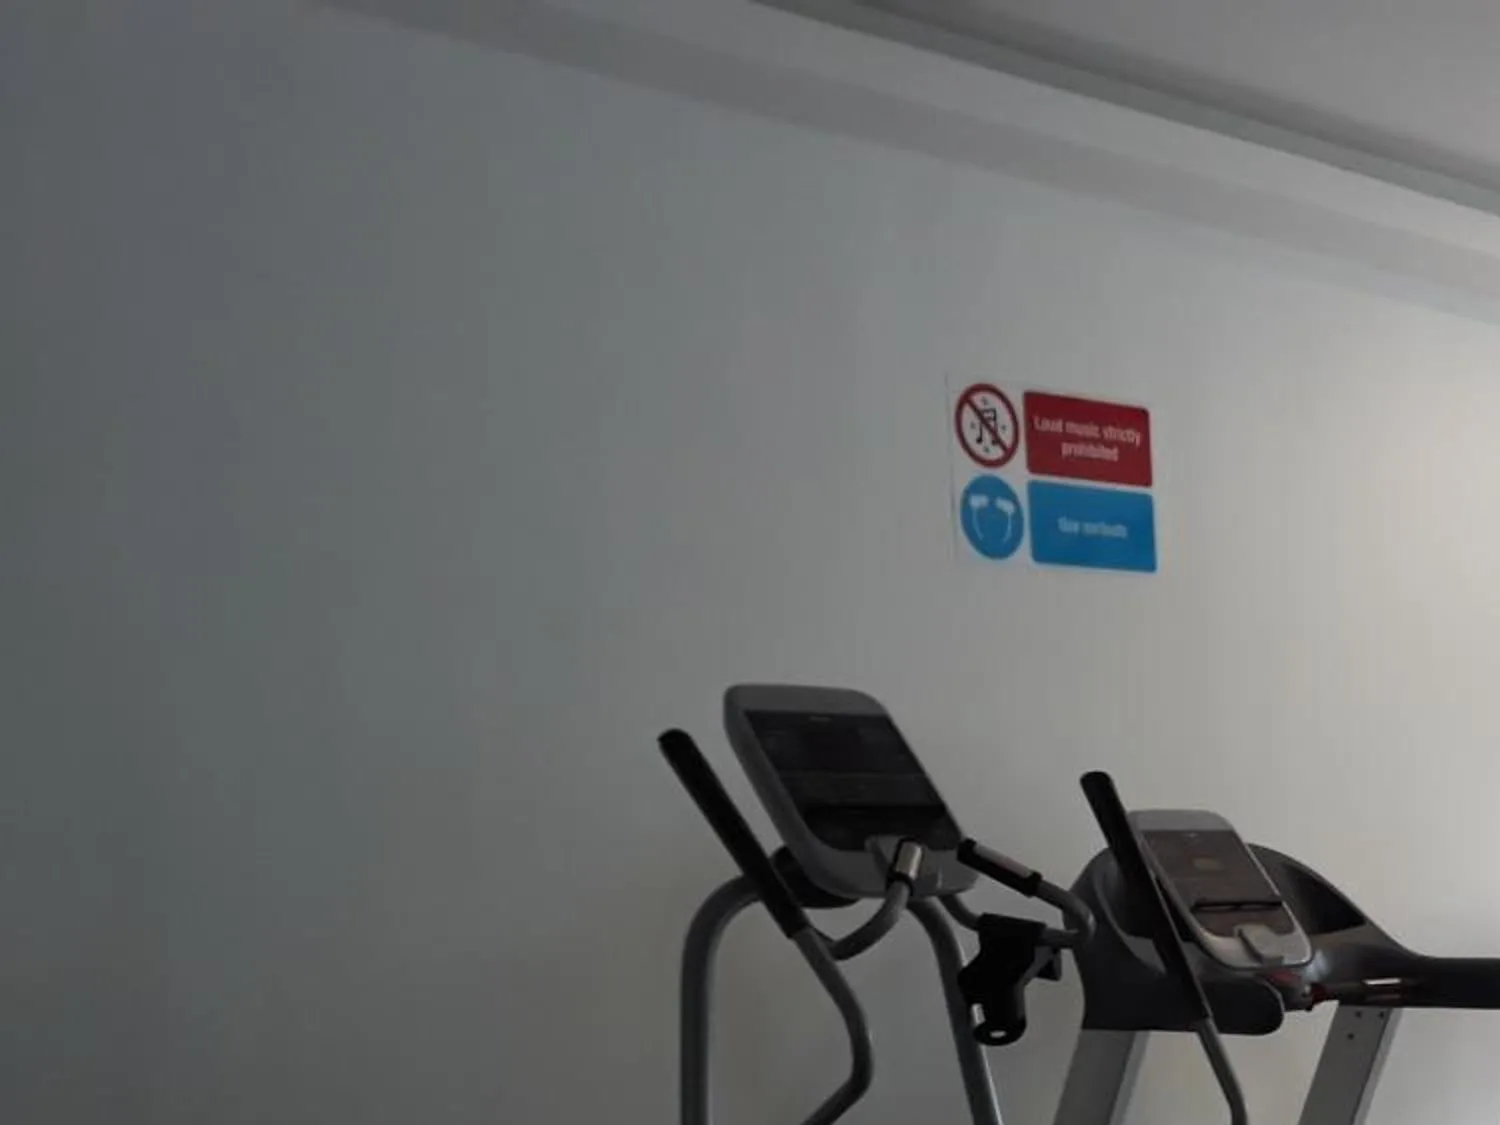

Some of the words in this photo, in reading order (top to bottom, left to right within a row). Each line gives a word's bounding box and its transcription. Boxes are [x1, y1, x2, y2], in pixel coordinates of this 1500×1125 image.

[1033, 415, 1063, 434] Loud
[1066, 422, 1100, 438] music
[1103, 426, 1141, 448] strictly
[1061, 442, 1119, 462] prohibited
